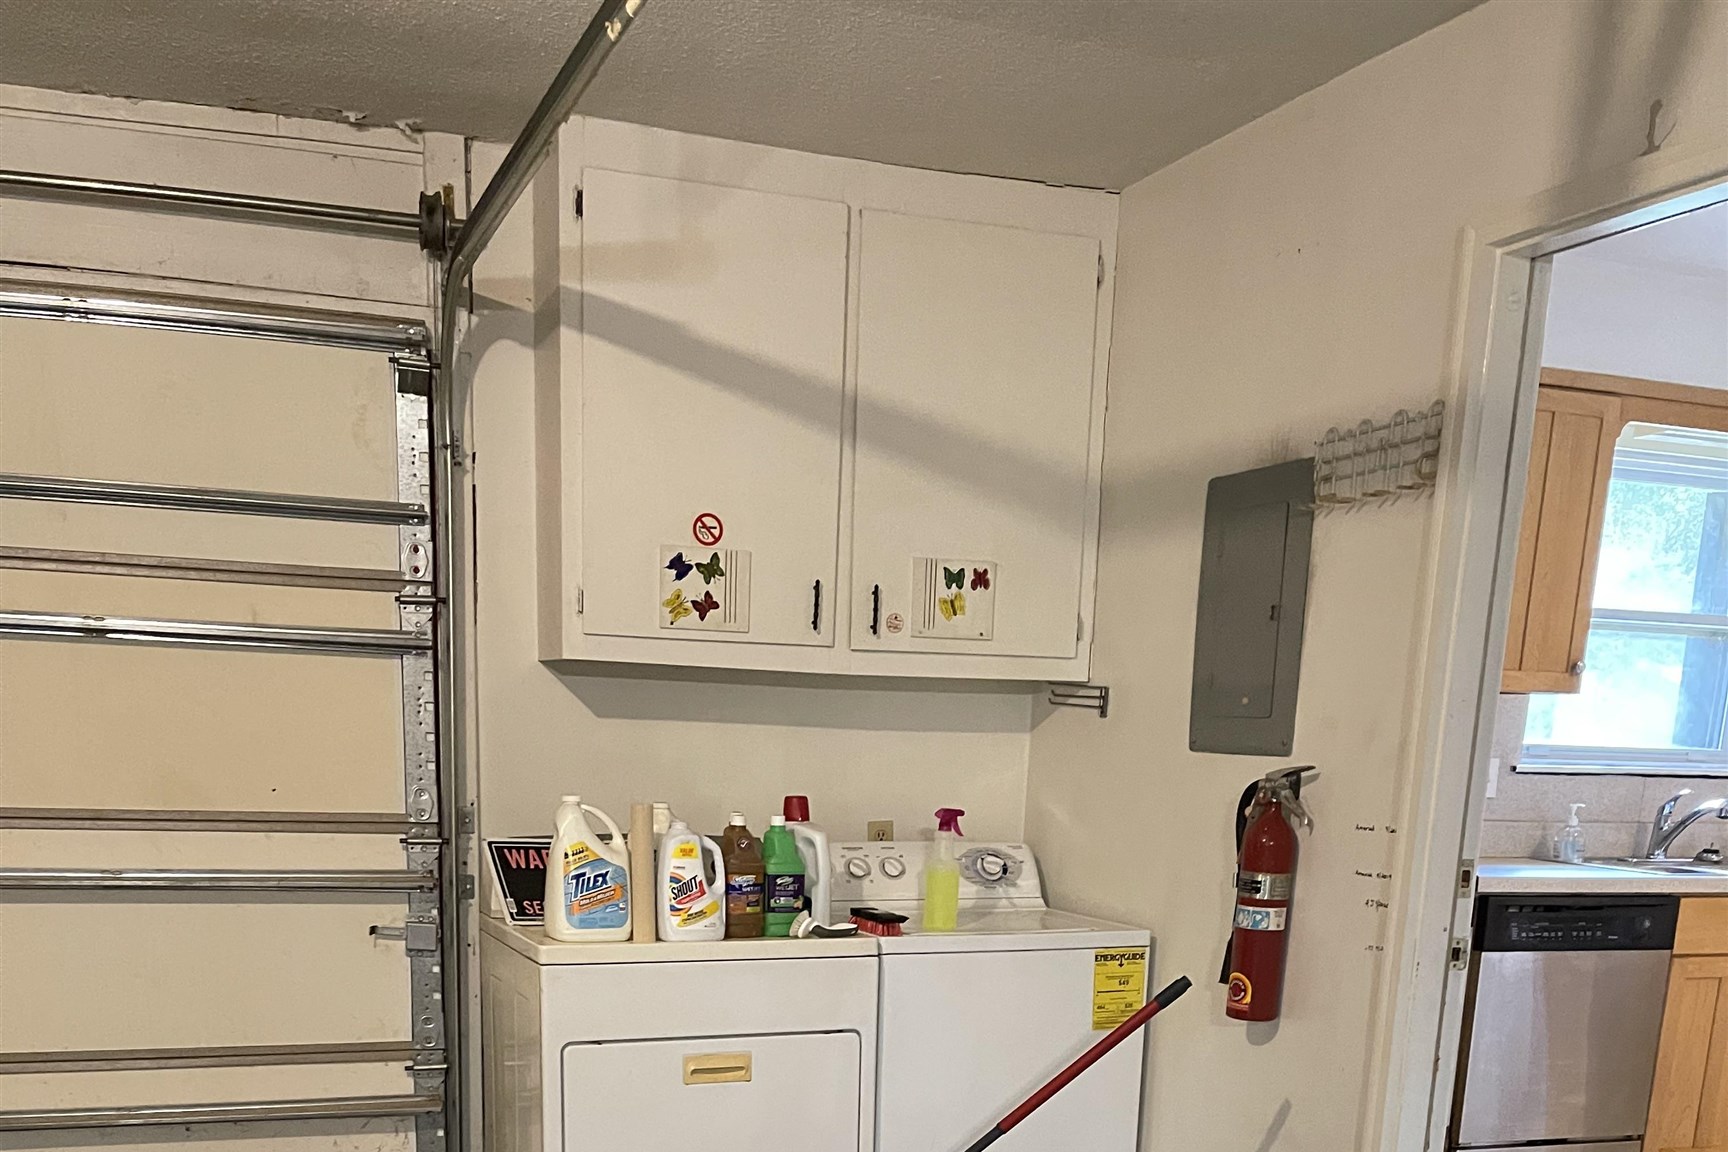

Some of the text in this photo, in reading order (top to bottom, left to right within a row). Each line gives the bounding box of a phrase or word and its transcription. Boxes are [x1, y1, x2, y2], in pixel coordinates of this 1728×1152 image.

[570, 870, 610, 900] TILEX
[671, 875, 698, 900] SHOUT
[522, 900, 545, 914] SE
[1095, 952, 1146, 962] ENERGYGUIDE
